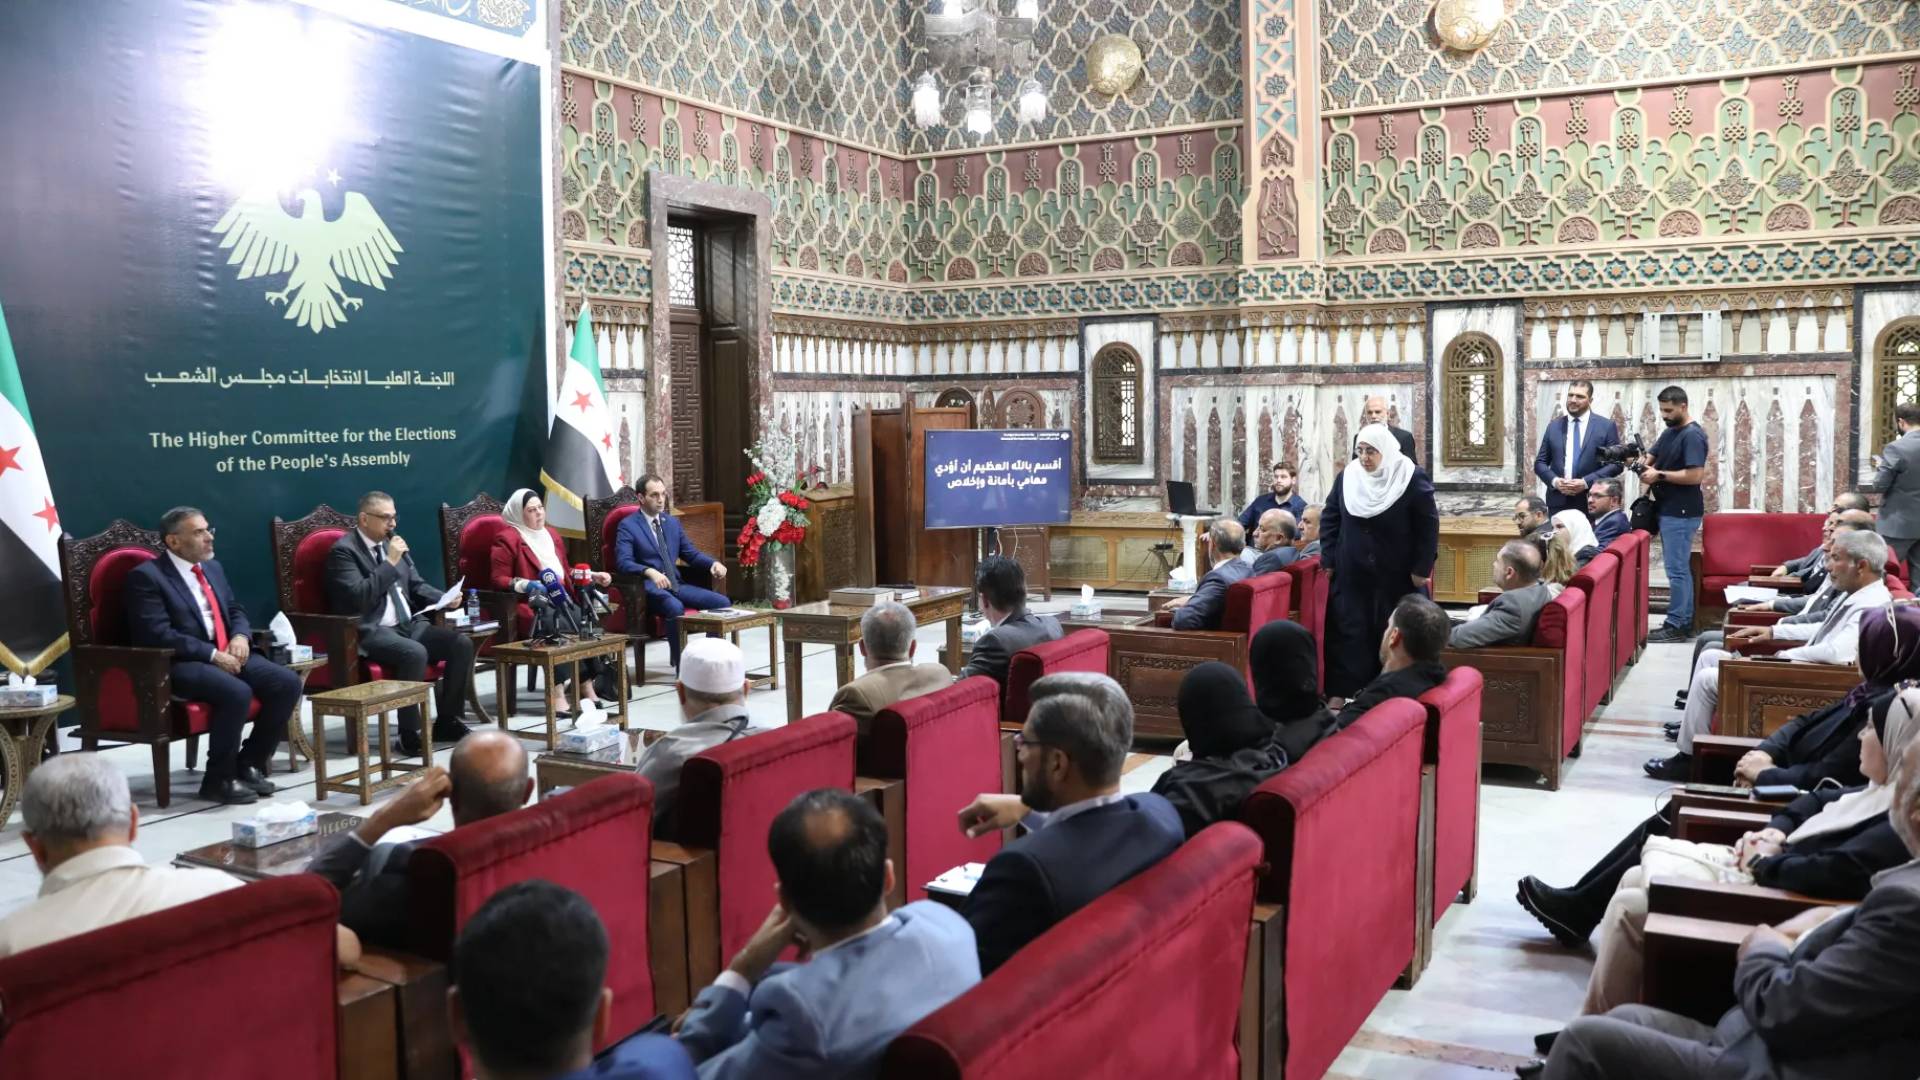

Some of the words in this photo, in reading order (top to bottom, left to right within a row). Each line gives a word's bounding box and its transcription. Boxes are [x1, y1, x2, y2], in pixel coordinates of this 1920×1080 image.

[144, 366, 217, 388] الشعب
[219, 368, 286, 389] مجلس
[288, 368, 362, 389] لانتخابات
[365, 370, 411, 389] العليا
[414, 371, 454, 390] اللجنة
[149, 432, 184, 448] The
[188, 431, 247, 449] Higher
[251, 429, 339, 446] Committee
[342, 428, 365, 443] for
[368, 428, 392, 442] the
[395, 427, 456, 441] Elections
[216, 457, 235, 472] of
[239, 456, 266, 471] the
[270, 454, 338, 472] People's
[341, 451, 411, 467] Assembly
[934, 459, 958, 477] أؤدي
[960, 458, 972, 473] أن
[973, 460, 1009, 474] العظيم
[1012, 460, 1032, 472] بالله
[1034, 458, 1062, 474] أقسم
[947, 476, 985, 490] وإخلاص
[987, 473, 1015, 487] بأمانة
[1017, 476, 1047, 490] مهامي
